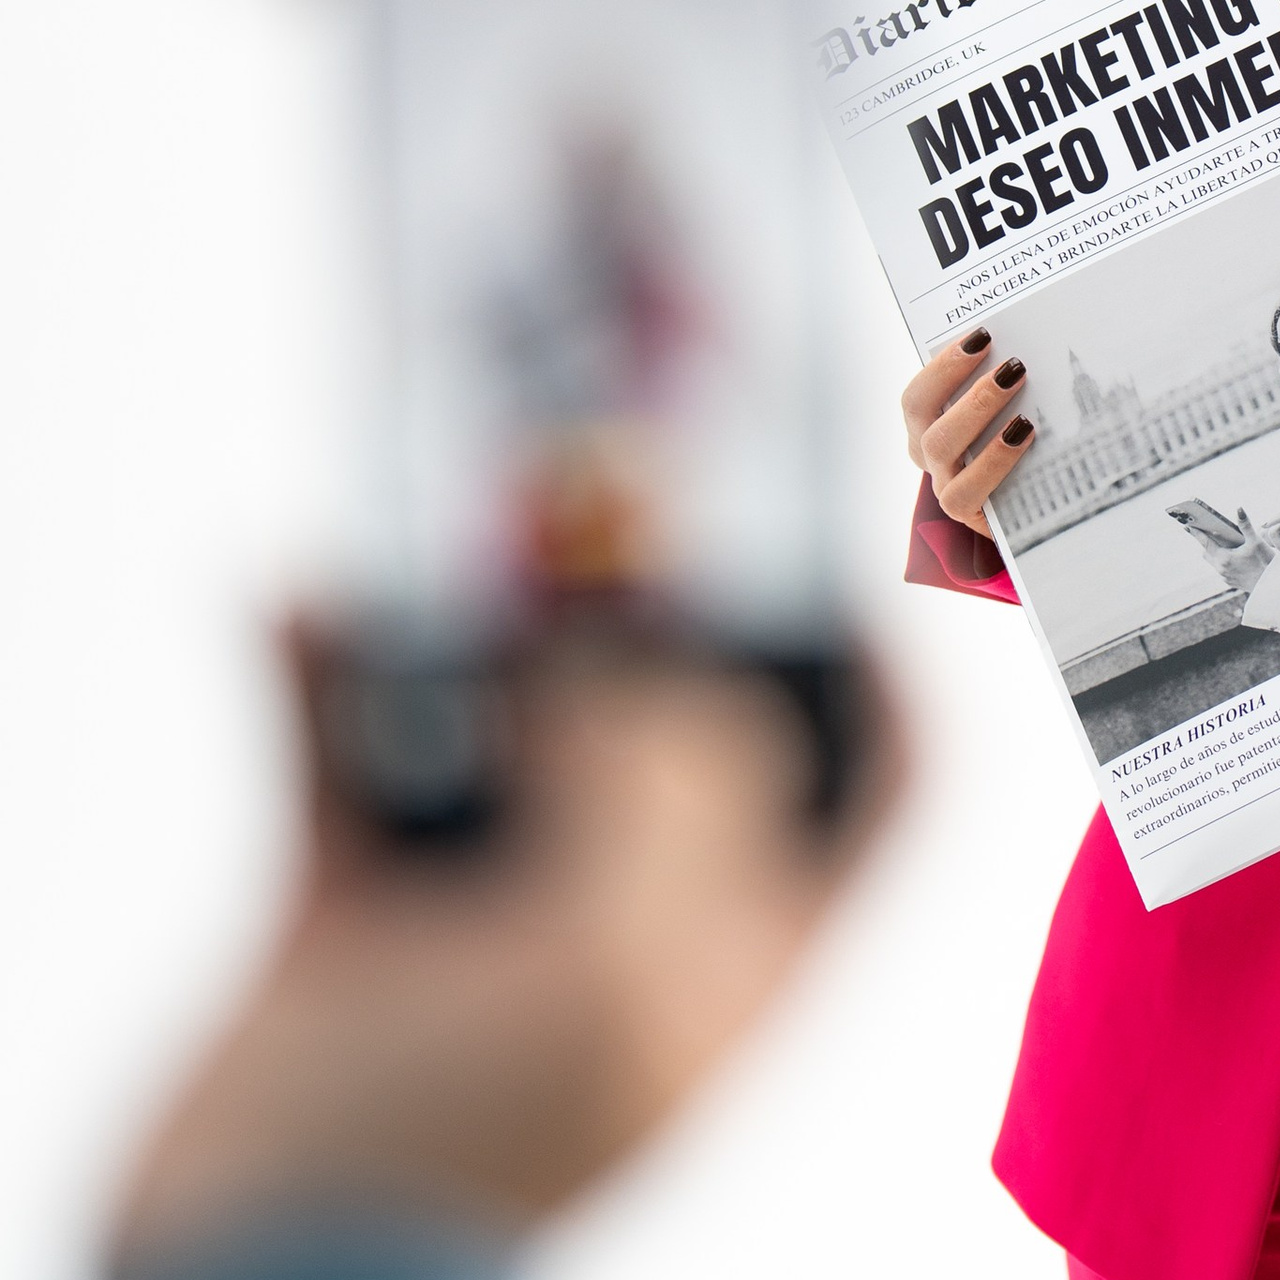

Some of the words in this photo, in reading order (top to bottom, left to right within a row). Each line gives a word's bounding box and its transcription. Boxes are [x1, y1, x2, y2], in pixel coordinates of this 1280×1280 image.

[840, 107, 859, 125] 123
[862, 56, 960, 112] CAMBRIDGE,
[961, 41, 987, 60] UK
[918, 127, 1109, 270] DESEO
[945, 267, 1041, 324] FINANCIERA
[1042, 257, 1053, 271] Y
[1057, 210, 1154, 265] BRINDARTE
[1155, 200, 1179, 217] LA
[1180, 159, 1263, 205] LIBERTAD
[956, 270, 991, 299] ¡NOS
[992, 243, 1045, 276] LLENA
[1046, 228, 1071, 248] DE
[1072, 190, 1150, 236] EMOCIÓN
[1154, 145, 1246, 197] AYUDARTE
[1249, 140, 1261, 153] A
[1111, 735, 1183, 783] NUESTRA
[1187, 694, 1266, 743] HISTORIA
[1120, 789, 1130, 803] A
[1130, 783, 1144, 795] lo
[1144, 766, 1177, 788] largo
[1180, 757, 1195, 770] de
[1197, 740, 1227, 761] años
[1229, 731, 1245, 745] de
[1126, 771, 1212, 821] revolucionario
[1214, 759, 1235, 775] fue
[1133, 787, 1230, 840] extraordinarios,
